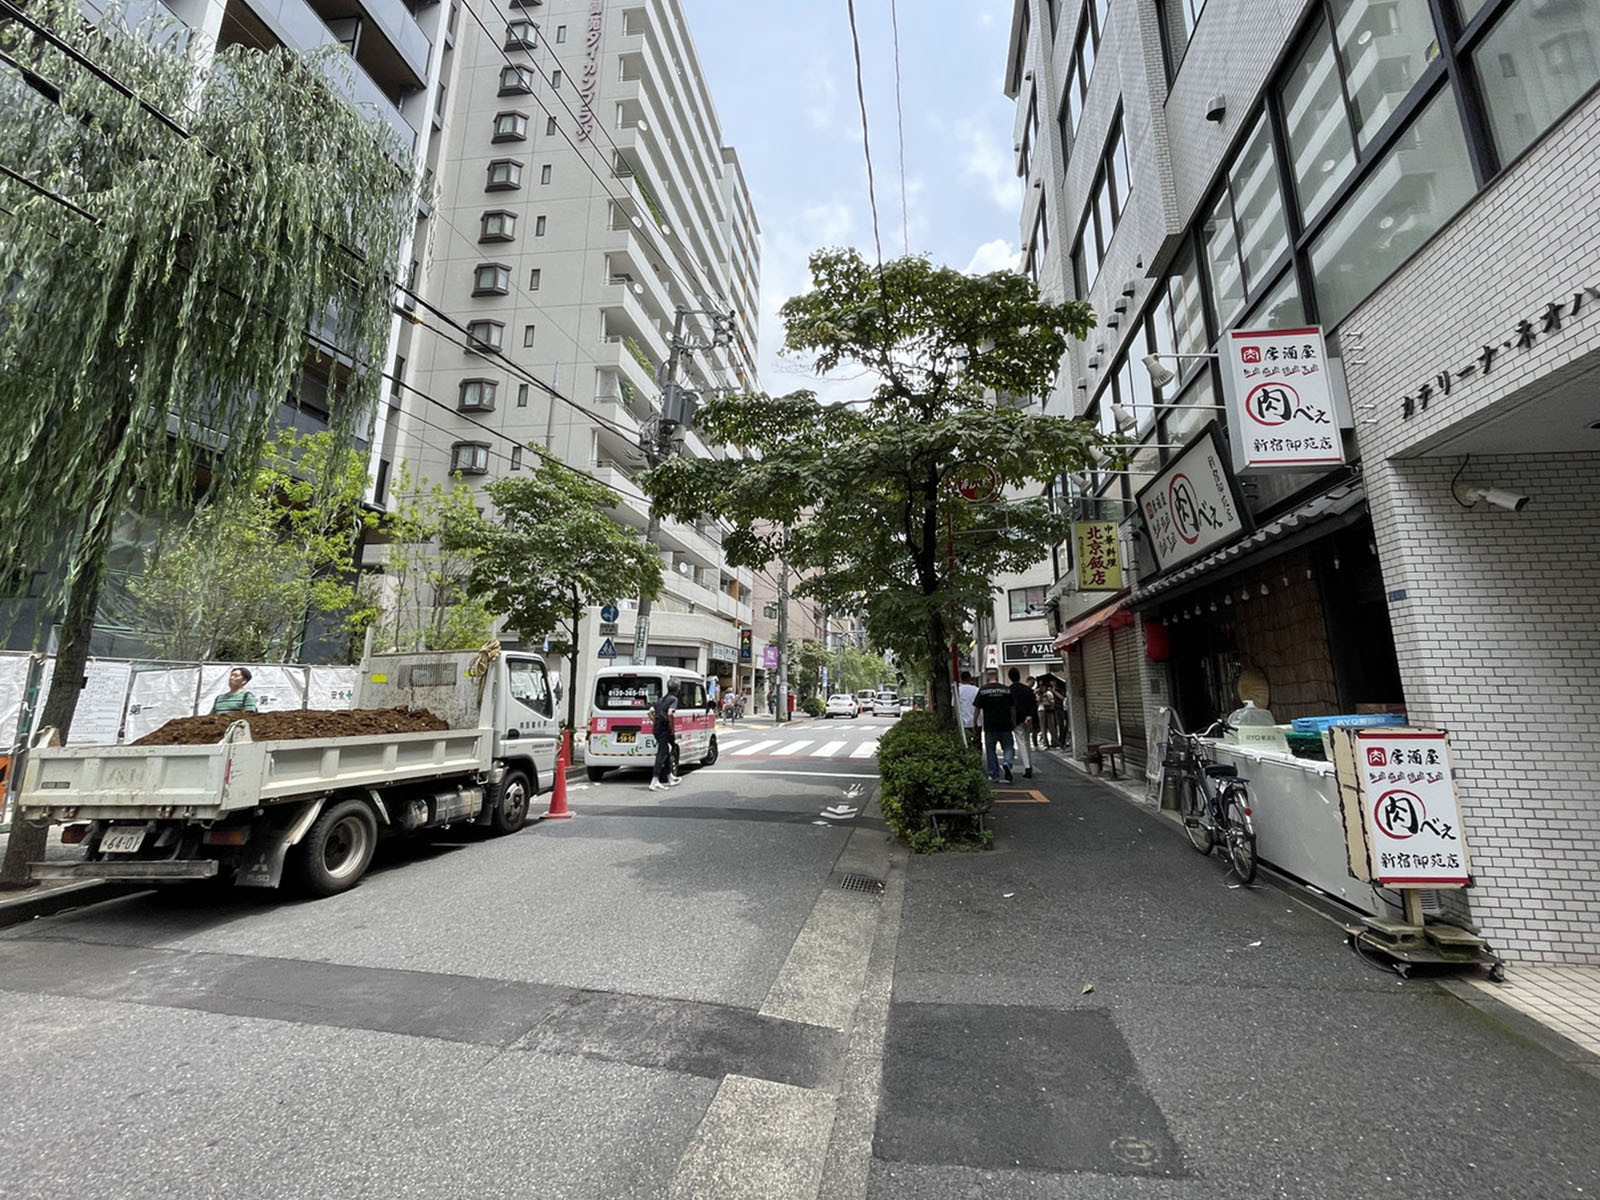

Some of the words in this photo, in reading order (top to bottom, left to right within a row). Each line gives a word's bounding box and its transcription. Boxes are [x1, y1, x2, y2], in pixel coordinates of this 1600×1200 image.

[1253, 436, 1332, 452] 新宿御苑店
[1087, 526, 1109, 585] 北京飯店
[1104, 524, 1117, 567] 中華料理
[1380, 853, 1460, 869] 新宿御苑店
